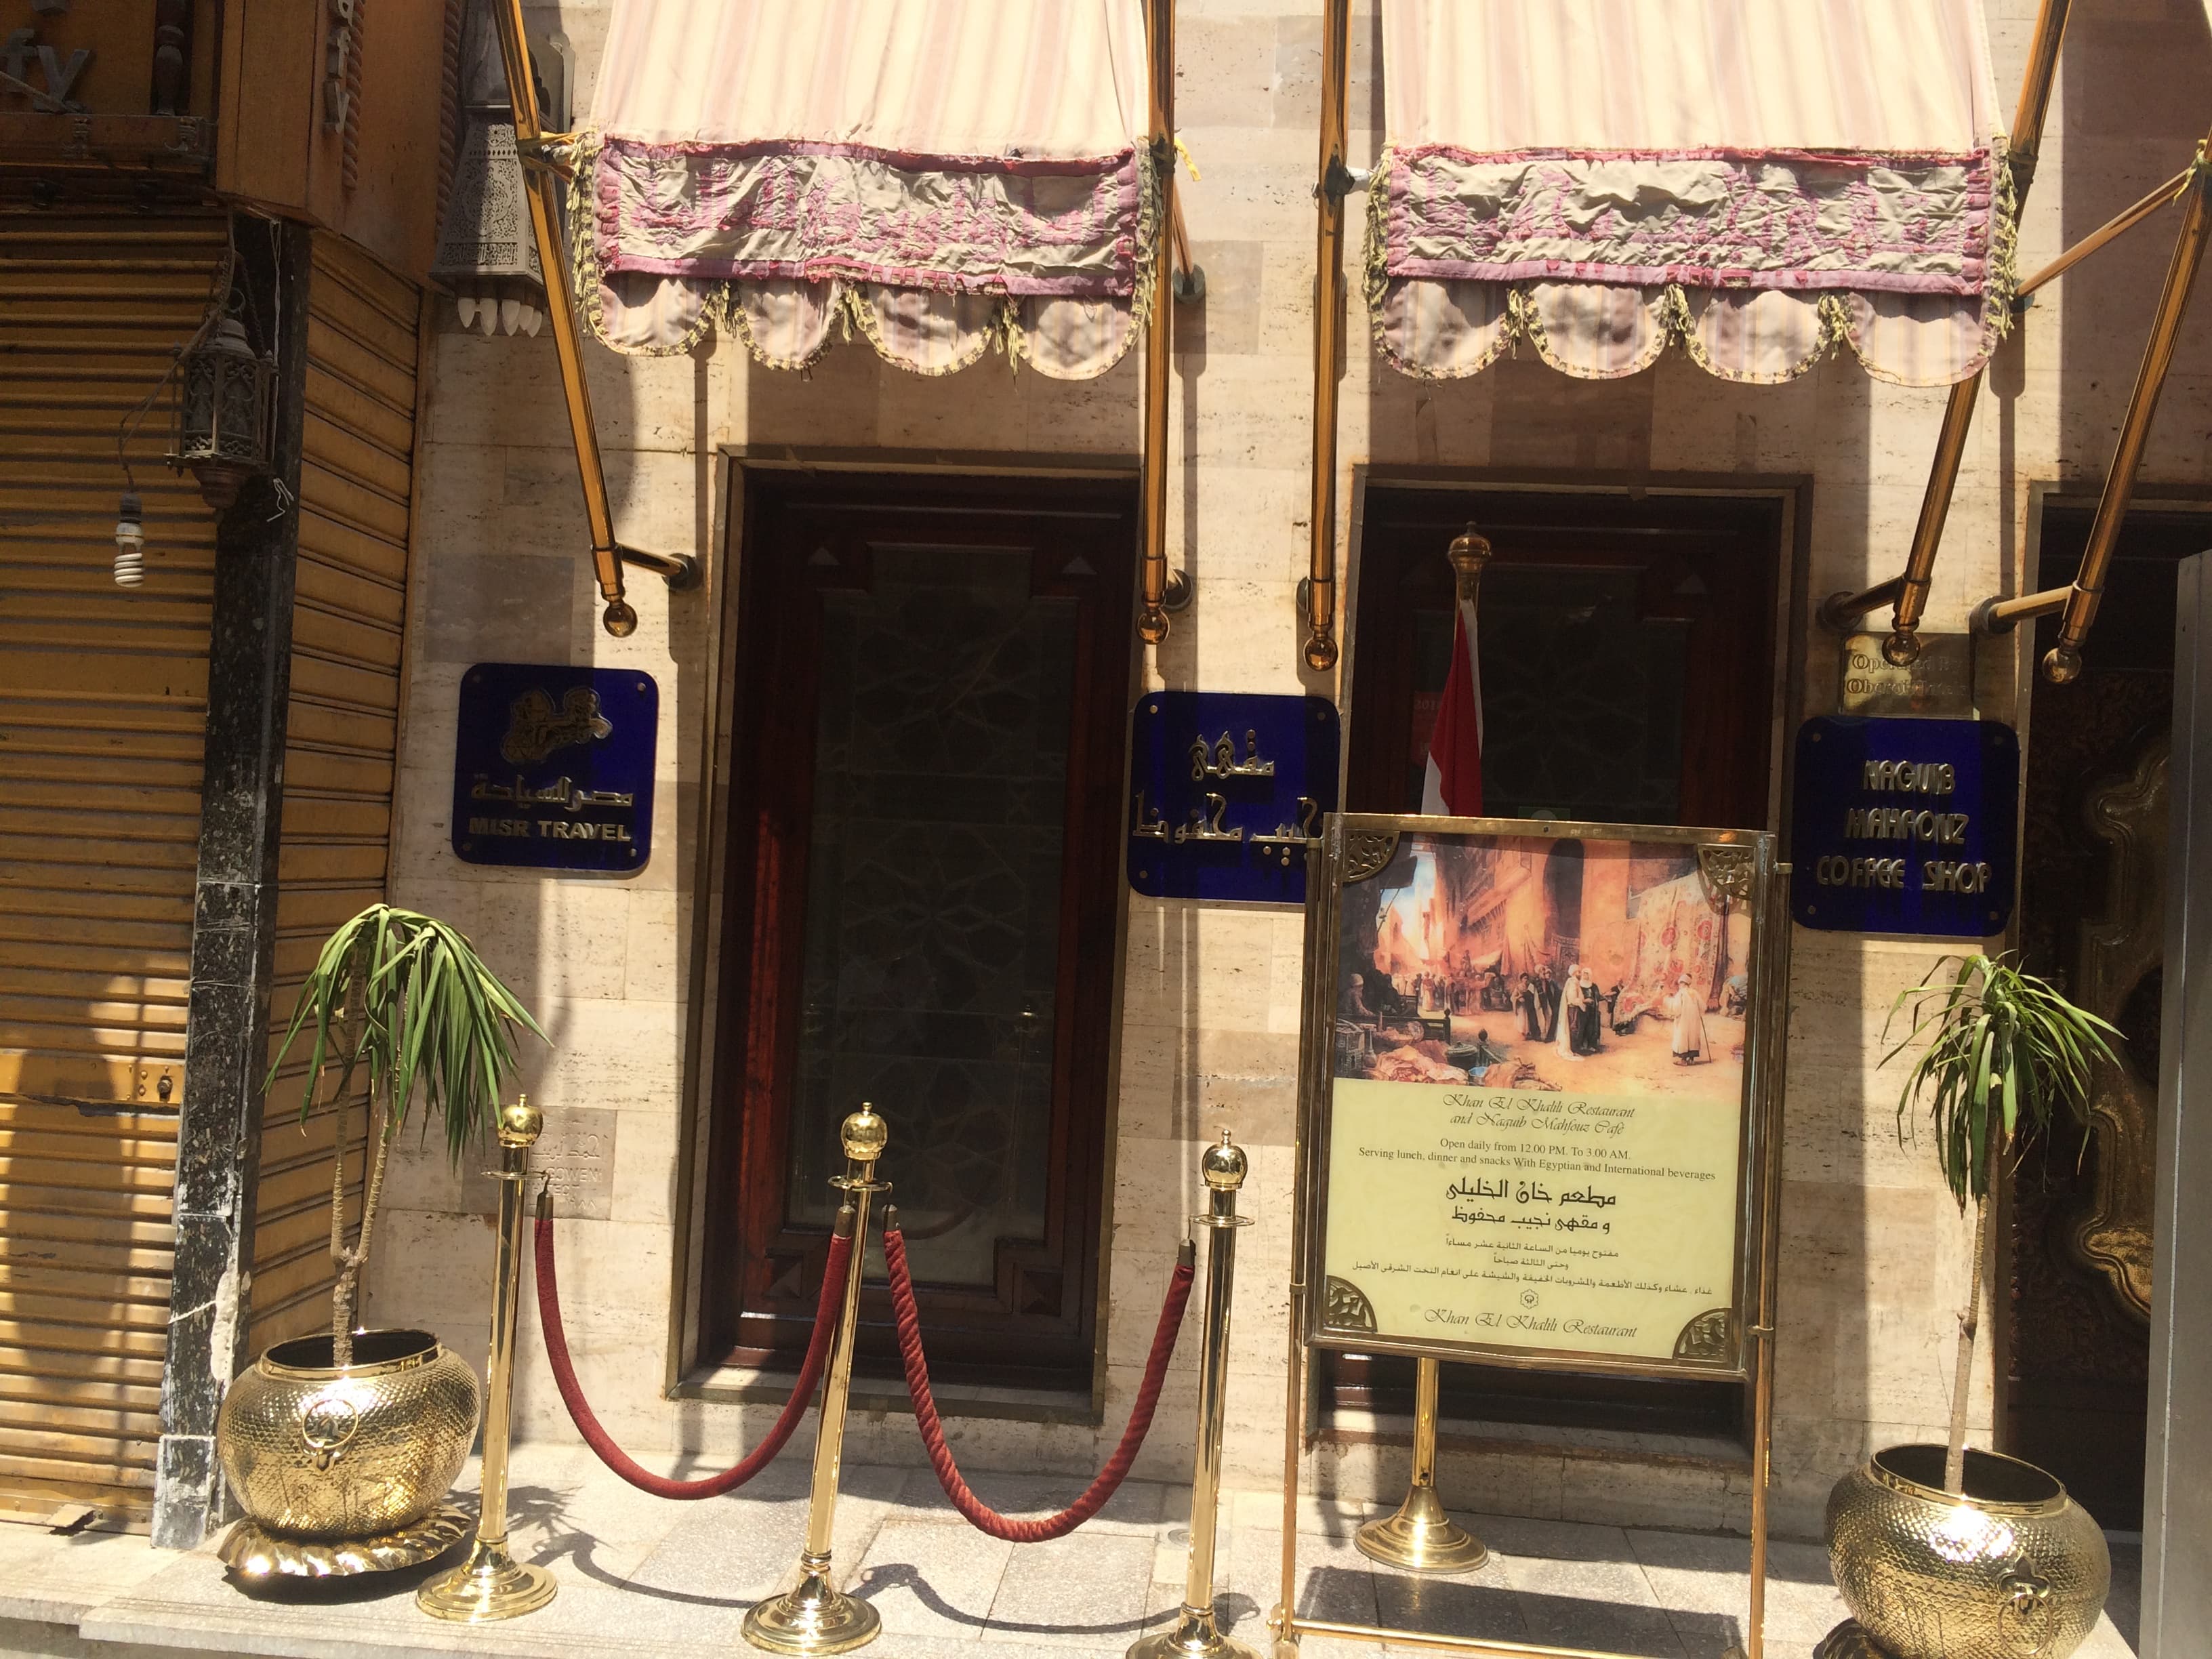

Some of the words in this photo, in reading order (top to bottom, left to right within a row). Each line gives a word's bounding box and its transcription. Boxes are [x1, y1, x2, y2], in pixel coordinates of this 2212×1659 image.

[1862, 760, 1956, 795] NAGUIB
[564, 790, 634, 812] مصر
[469, 817, 531, 838] MISR
[537, 820, 632, 842] TRAVEL
[1843, 807, 1969, 845] MAHFOUZ
[1817, 855, 1906, 889] COFFEE
[1922, 861, 1992, 893] SHOP
[1443, 1093, 1483, 1108] Khan
[1488, 1097, 1513, 1109] El
[1516, 1098, 1562, 1113] Khalili
[1567, 1101, 1636, 1118] Restaurant
[1450, 1112, 1472, 1125] and
[1475, 1111, 1527, 1131] Naguib
[1531, 1117, 1591, 1136] Mahfouz
[1439, 1138, 1465, 1149] Open
[1468, 1140, 1491, 1152] daily
[1494, 1141, 1517, 1152] from
[1520, 1143, 1546, 1153] 12.00
[1549, 1145, 1568, 1155] PM.
[1571, 1147, 1583, 1156] To
[1586, 1148, 1607, 1158] 3.00
[1609, 1150, 1631, 1160] AM.
[1359, 1147, 1394, 1160] Serving
[1428, 1151, 1457, 1163] dinner
[1460, 1154, 1477, 1164] and
[1479, 1155, 1511, 1166] snacks
[1513, 1157, 1536, 1168] With
[1539, 1159, 1581, 1172] Egyptian
[1584, 1162, 1601, 1172] and
[1604, 1164, 1665, 1176] International
[1667, 1168, 1717, 1181] beverages
[1515, 1181, 1552, 1204] خان
[1558, 1185, 1616, 1208] مطعم
[1452, 1205, 1506, 1225] محفوظ
[1510, 1212, 1551, 1230] نجيب
[1554, 1214, 1599, 1232] مقهى
[1473, 1239, 1494, 1249] عشر
[1496, 1241, 1521, 1250] الثانية
[1522, 1244, 1554, 1253] الساعة
[1424, 1308, 1470, 1325] Khan
[1475, 1313, 1502, 1328] El
[1506, 1314, 1558, 1332] Khalili
[1563, 1318, 1638, 1338] Restaurant
